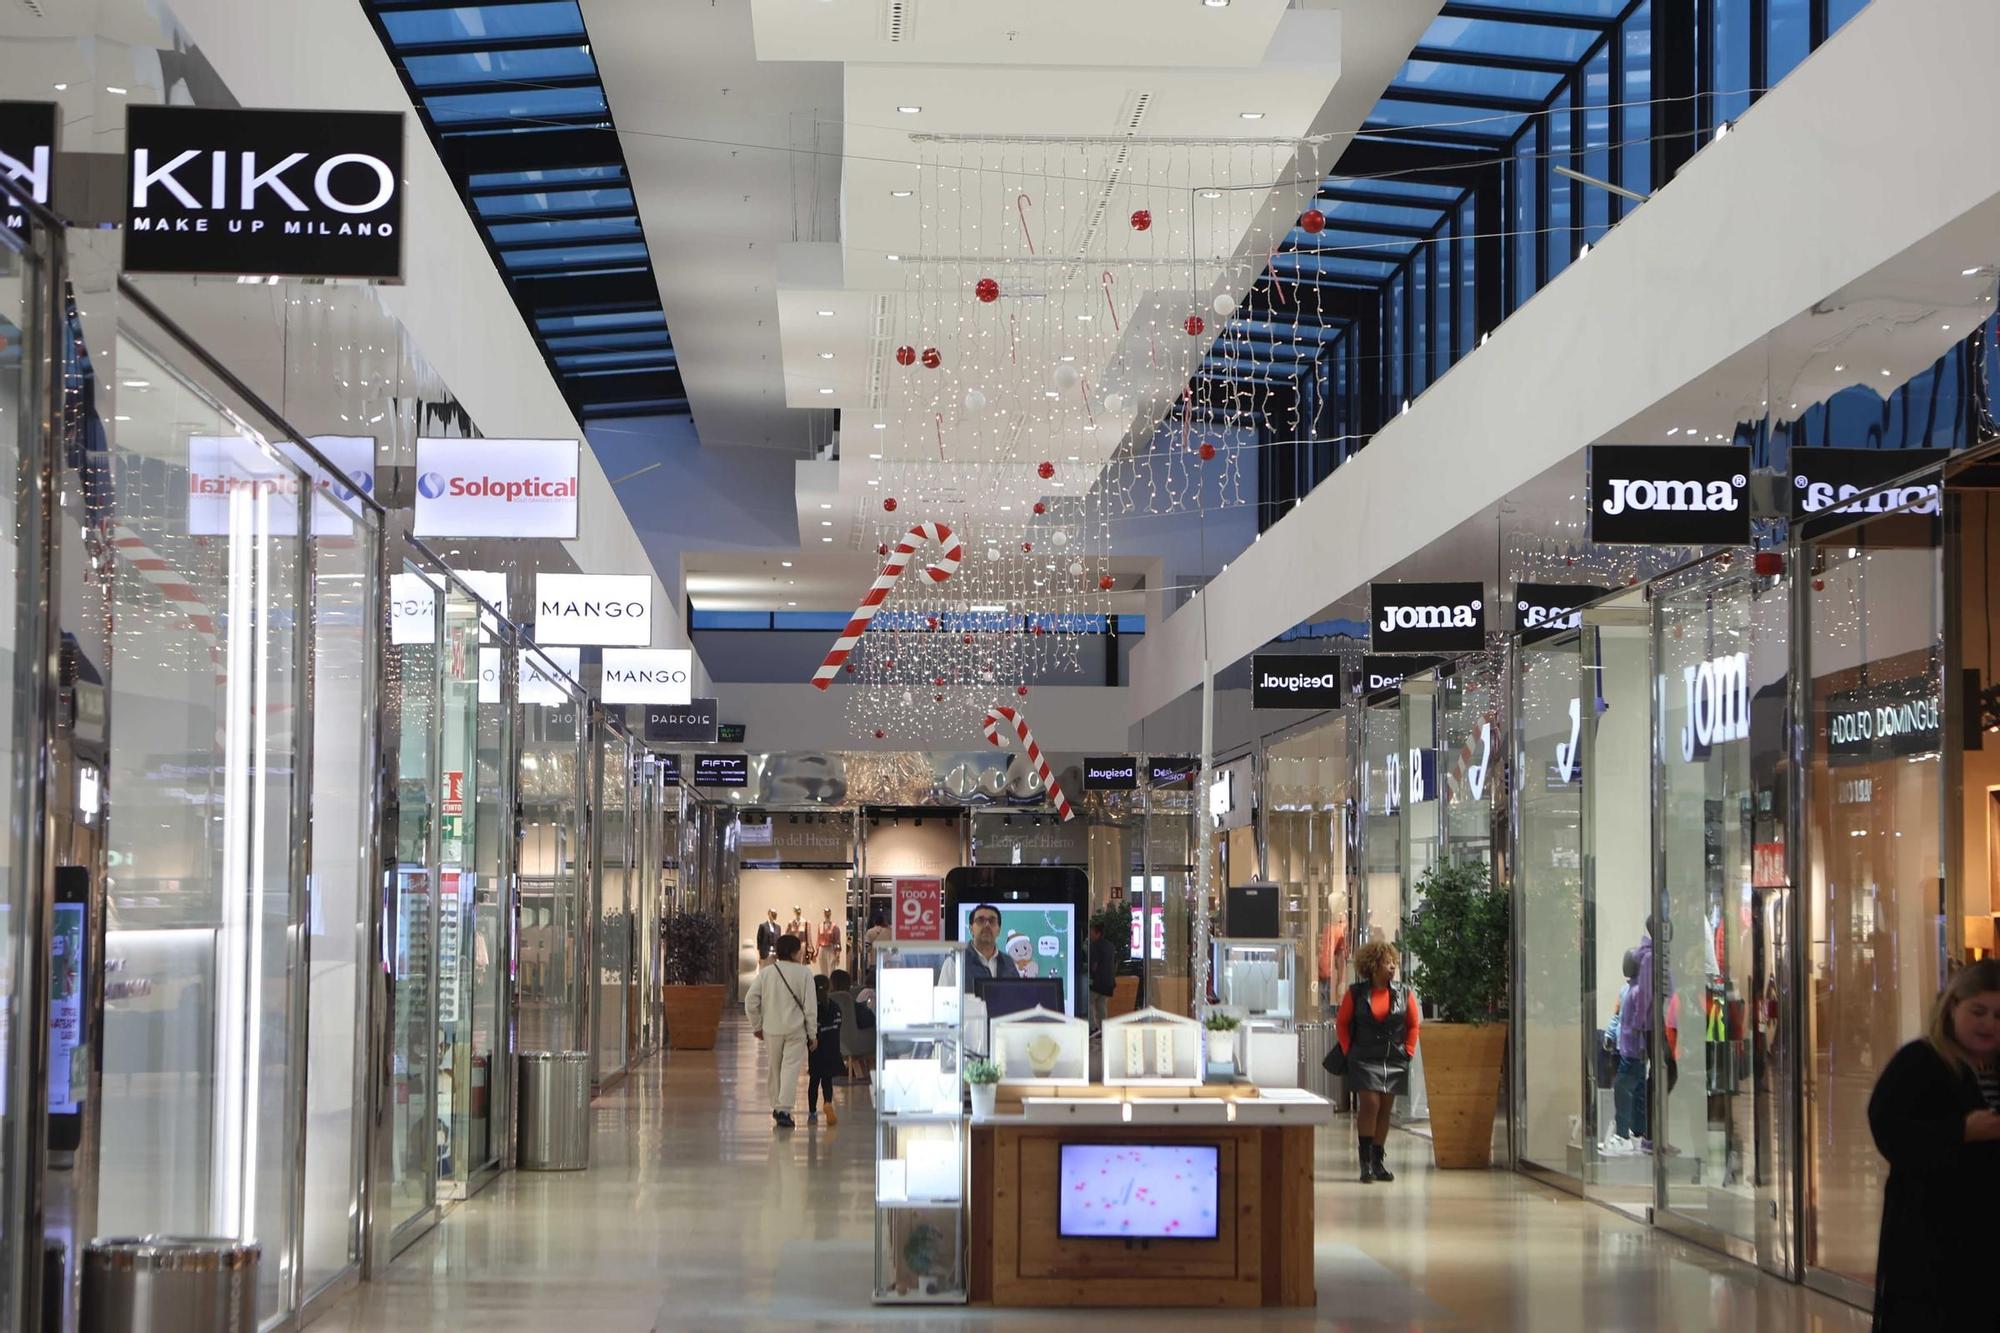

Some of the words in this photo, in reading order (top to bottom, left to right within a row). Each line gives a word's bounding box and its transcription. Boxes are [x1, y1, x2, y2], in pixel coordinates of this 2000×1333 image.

[133, 147, 395, 214] KIKO
[134, 216, 209, 232] MAKE
[228, 219, 265, 233] UP
[284, 220, 393, 237] MILANO
[449, 476, 576, 503] Soloptical
[541, 601, 644, 618] MANGO
[606, 670, 687, 683] MANGO
[1831, 710, 1873, 745] ADOLFO
[701, 759, 741, 768] FIFTY
[900, 890, 927, 899] TODO
[929, 890, 937, 899] A
[902, 898, 934, 926] 9€
